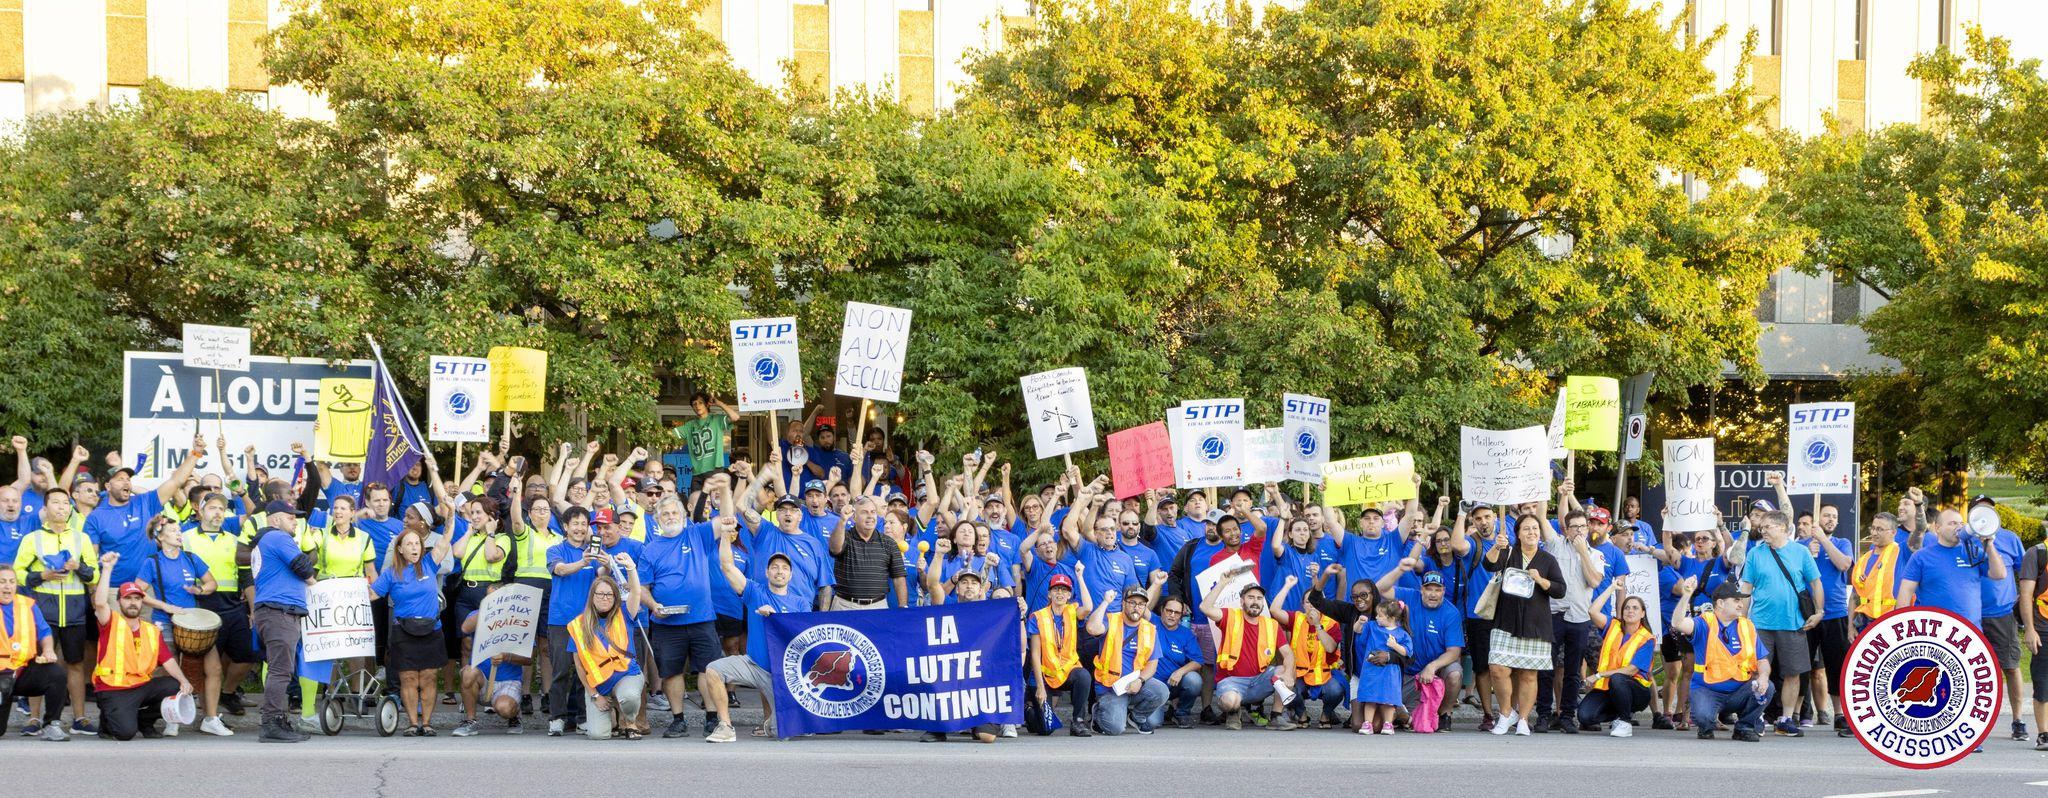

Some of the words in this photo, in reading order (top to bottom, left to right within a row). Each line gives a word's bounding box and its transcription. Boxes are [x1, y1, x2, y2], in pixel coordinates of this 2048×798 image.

[735, 323, 792, 340] STTP
[848, 308, 906, 332] NON
[845, 337, 899, 362] AUX
[433, 361, 487, 375] STTP
[838, 364, 901, 393] RECULS
[150, 364, 185, 412] À
[333, 384, 353, 407] STL
[1185, 404, 1240, 420] STTP
[1286, 399, 1327, 416] STTP
[1793, 408, 1850, 424] STTP
[691, 428, 715, 457] 92
[1668, 444, 1704, 463] NON
[167, 448, 208, 469] MC
[1358, 470, 1373, 484] de
[1668, 471, 1705, 490] AUX
[1348, 482, 1393, 501] L'EST
[487, 594, 531, 610] L'HEURE
[508, 604, 532, 615] AUX
[790, 628, 827, 652] TRAVAILLEURS
[827, 627, 835, 640] ET
[926, 615, 960, 646] LA
[836, 628, 877, 660] TRAVAILLEUSES
[906, 649, 982, 684] LUTTE
[784, 663, 803, 694] SYNDICAT
[866, 670, 882, 694] POSTES
[801, 693, 821, 713] SECTION
[820, 701, 842, 717] LOCALE
[842, 702, 851, 716] DE
[883, 685, 1012, 720] CONTINUE
